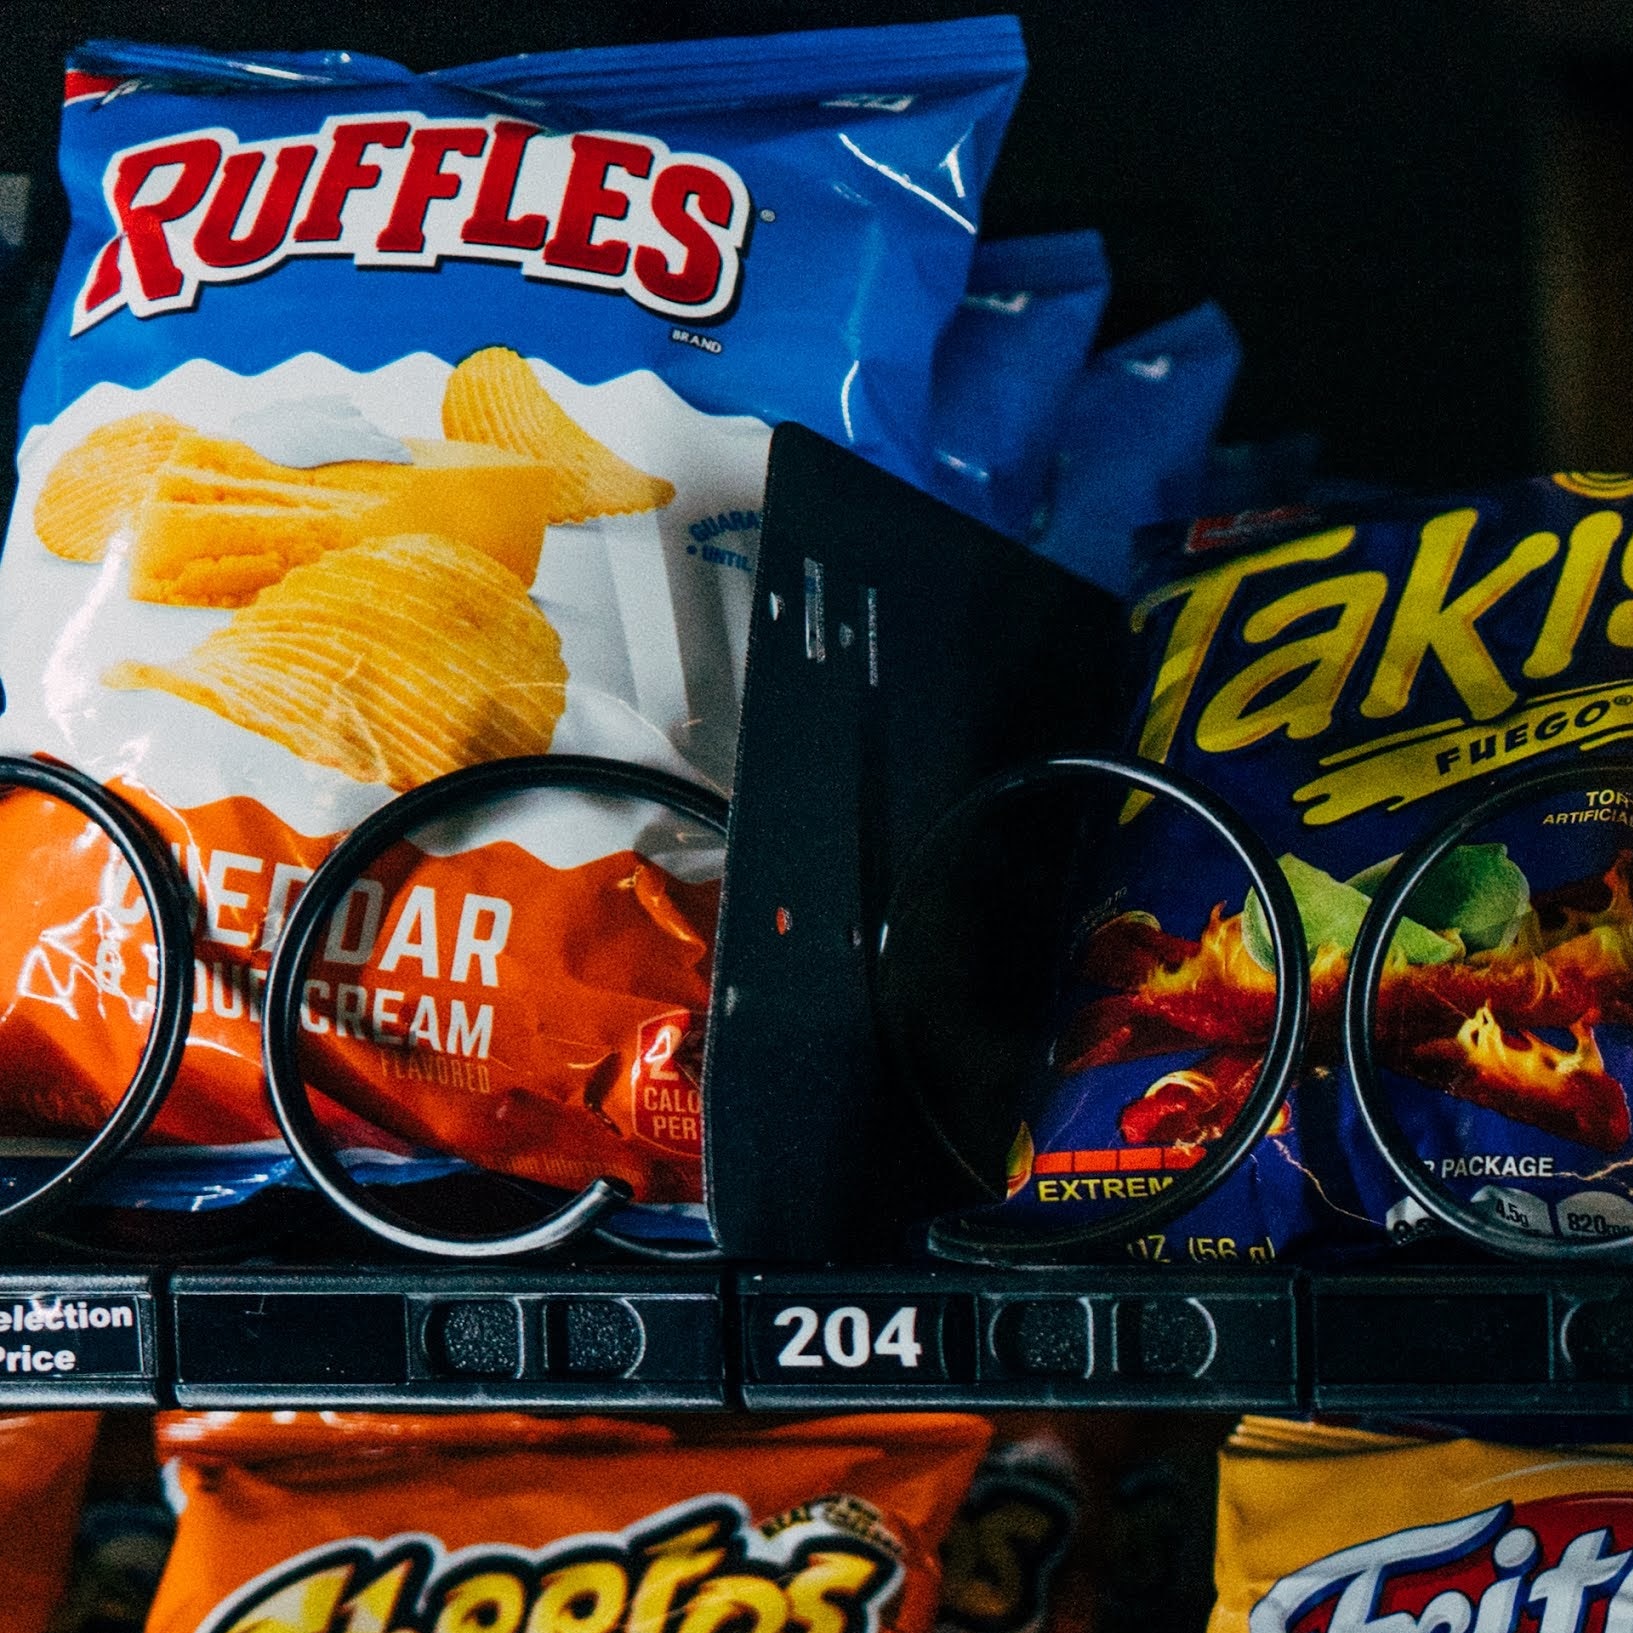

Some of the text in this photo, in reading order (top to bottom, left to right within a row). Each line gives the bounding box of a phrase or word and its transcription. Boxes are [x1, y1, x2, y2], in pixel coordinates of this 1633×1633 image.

[80, 118, 736, 310] RUFFLES
[672, 329, 722, 354] BRAND
[301, 978, 494, 1061] CREAM
[381, 1054, 491, 1095] FLAVORED
[1442, 1154, 1554, 1182] PACKAGE
[775, 1307, 923, 1370] 204
